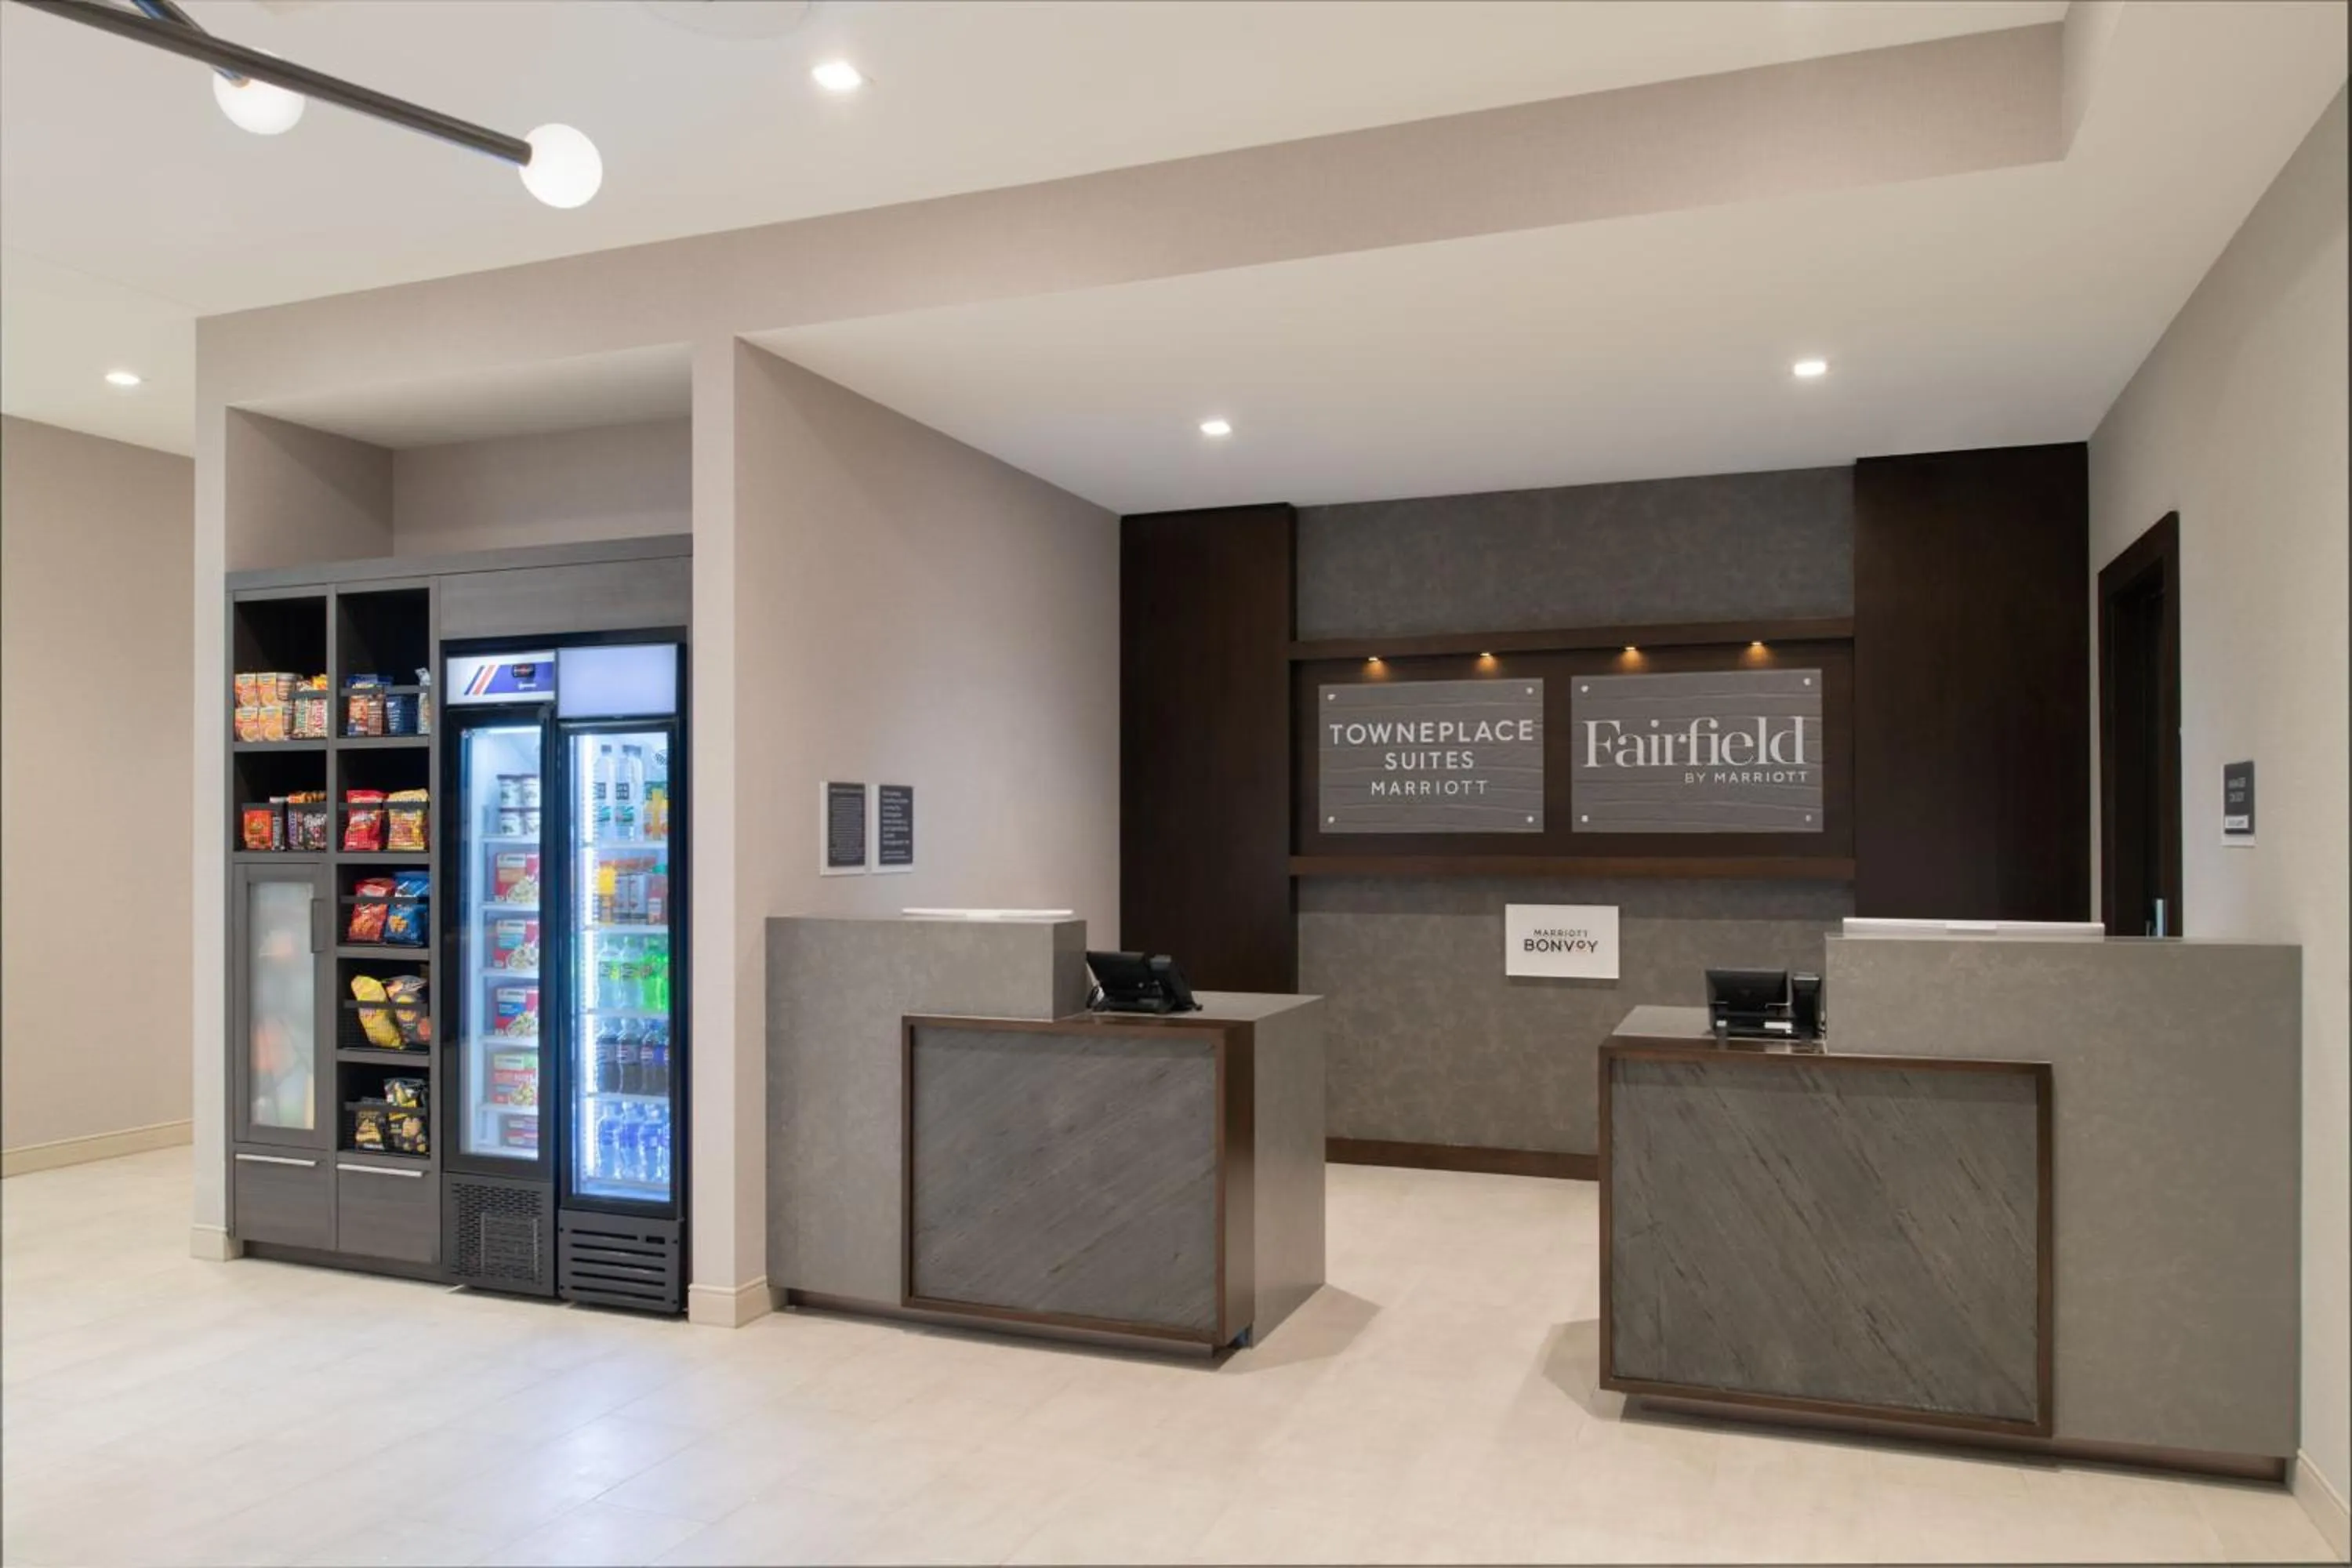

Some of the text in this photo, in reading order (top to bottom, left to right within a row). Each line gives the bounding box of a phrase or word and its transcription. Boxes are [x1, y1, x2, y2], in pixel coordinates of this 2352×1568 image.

[1330, 720, 1534, 745] TOWNEPLACE
[1582, 716, 1807, 768] Fairfield
[1385, 750, 1475, 771] SUITES
[1686, 771, 1809, 784] BY MARRIOTT
[1371, 780, 1489, 796] MARRIOTT
[1523, 938, 1599, 953] BONVOY
